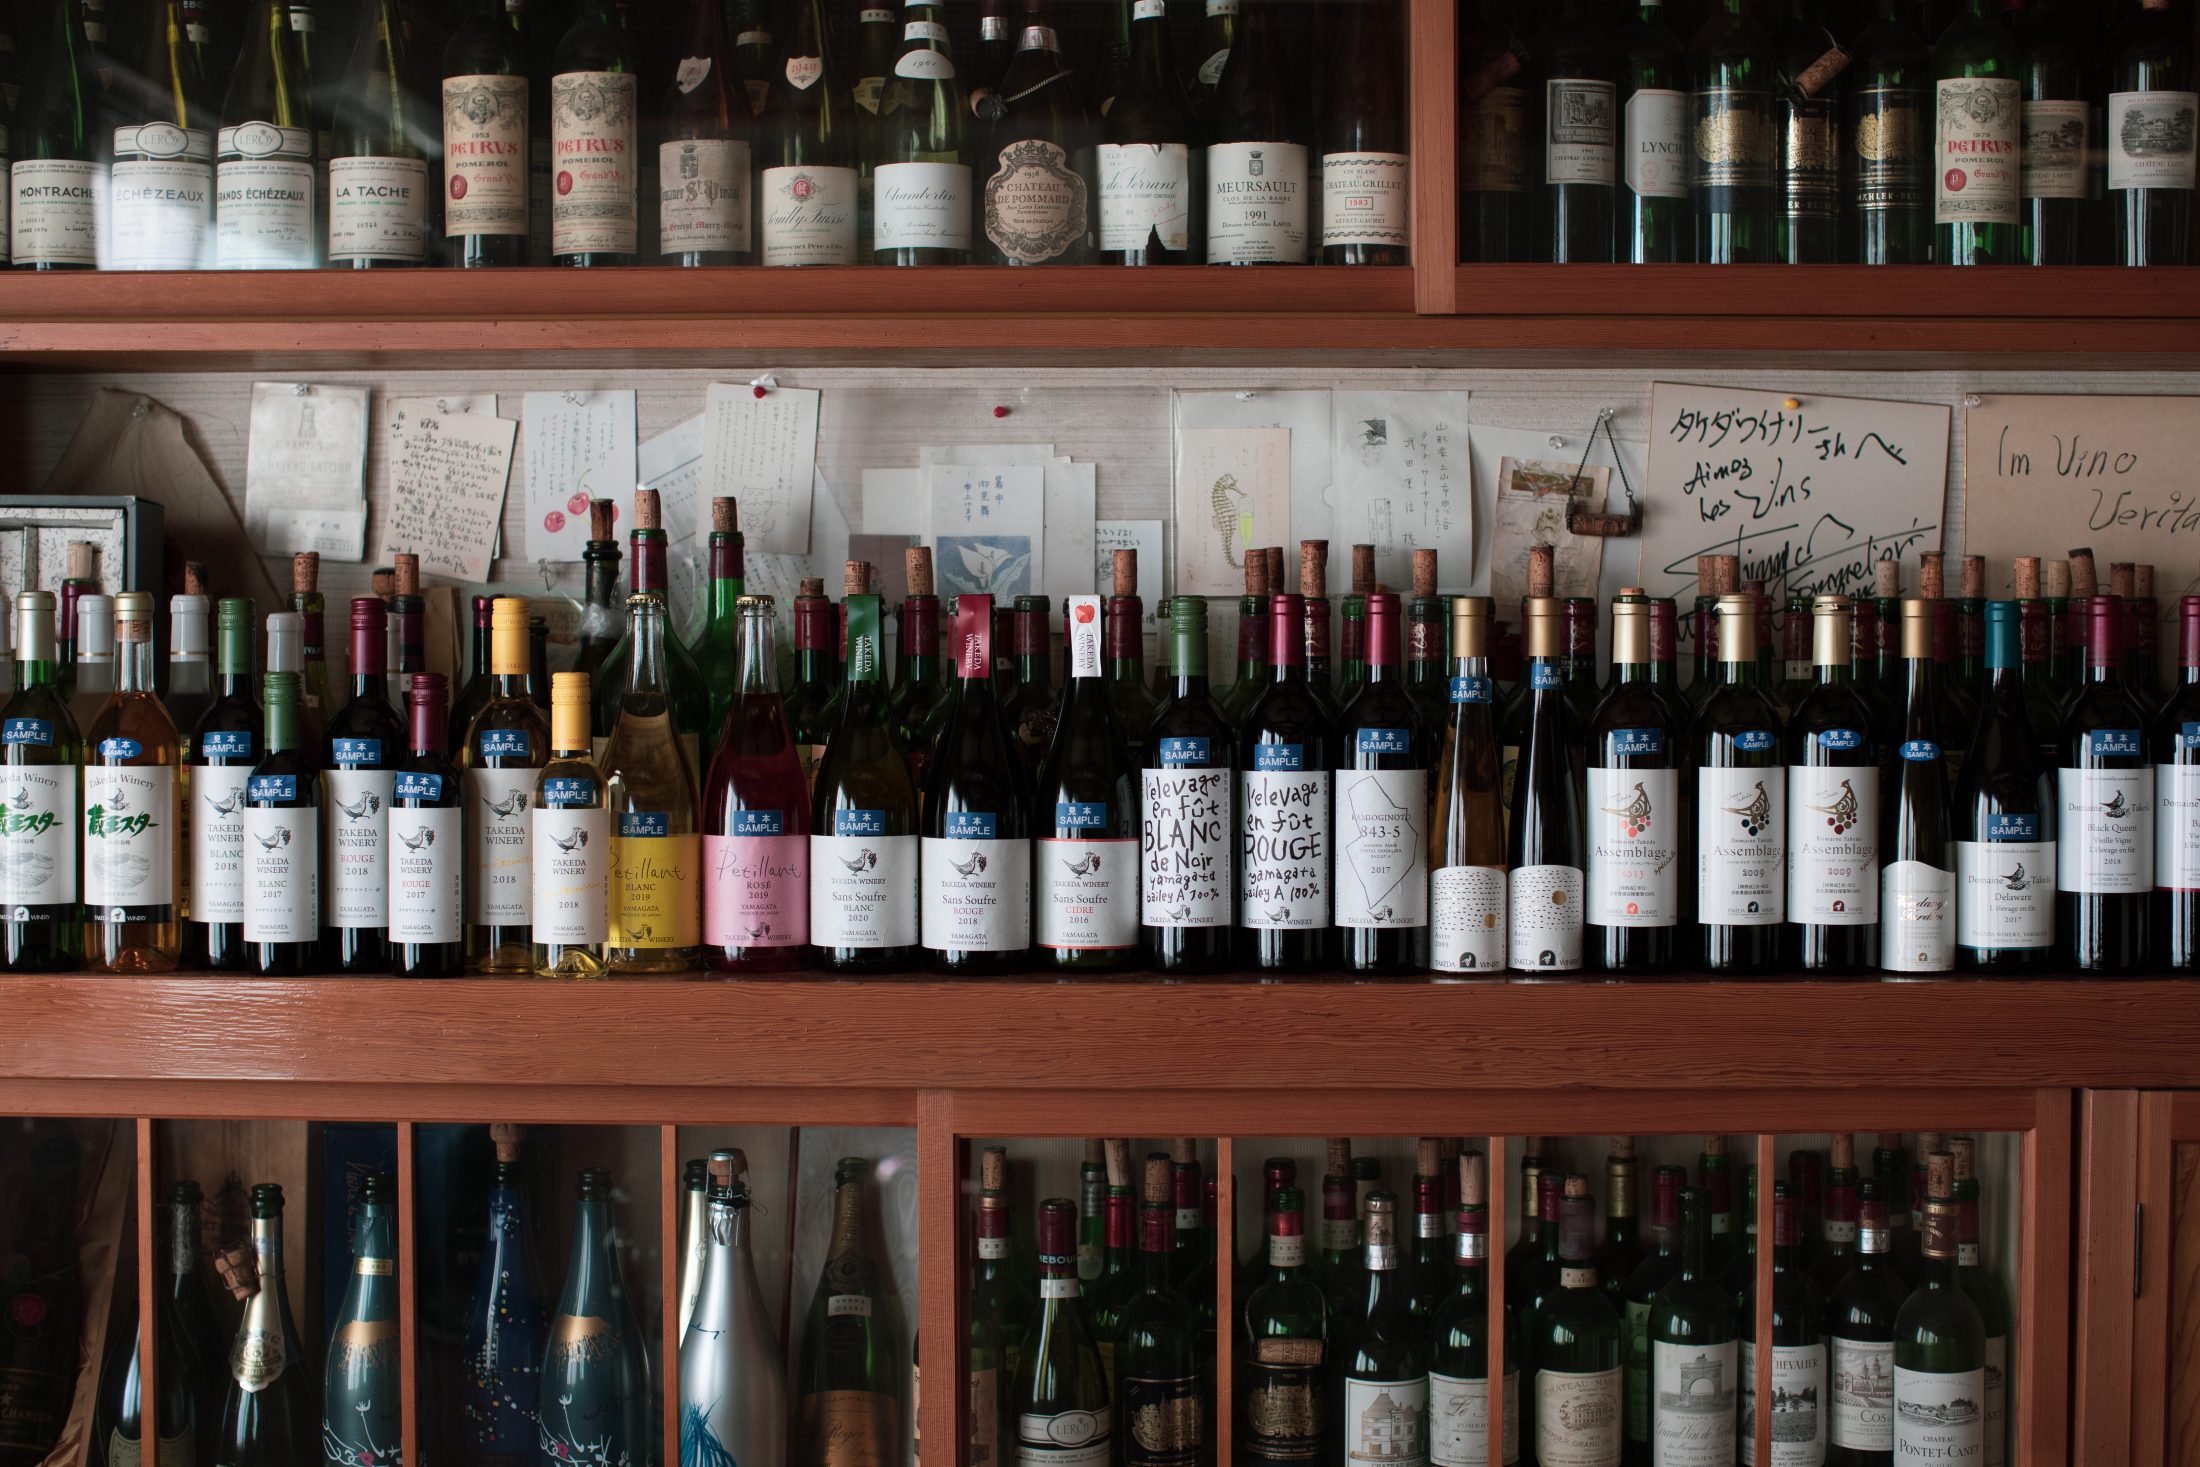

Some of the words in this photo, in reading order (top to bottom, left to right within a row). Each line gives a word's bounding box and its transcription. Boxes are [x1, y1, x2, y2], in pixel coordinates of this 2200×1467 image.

[240, 132, 276, 146] LEROY
[1642, 141, 1682, 154] LYNCH
[1024, 171, 1040, 180] 1978
[1006, 183, 1060, 192] CHATEAU
[1217, 182, 1297, 194] MEURSAULT
[116, 186, 204, 202] ÉCHÉZEAUX
[246, 187, 304, 201] ÉCHÉZEAUX
[336, 187, 350, 198] LA
[357, 186, 410, 199] TACHE
[998, 195, 1010, 204] DE
[1012, 195, 1070, 204] POMMARD
[1246, 210, 1266, 220] 1991
[2052, 434, 2138, 478] Vino
[864, 634, 872, 673] TAKEDA
[973, 632, 982, 670] TAKEDA
[1078, 632, 1086, 670] WINERY
[1086, 632, 1094, 669] TAKEDA
[16, 722, 40, 730] 見本
[6, 730, 47, 740] SAMPLE
[212, 734, 236, 743] 見本
[492, 734, 516, 743] 見本
[1371, 732, 1395, 741] 見本
[343, 742, 367, 751] 見本
[484, 743, 524, 752] SAMPLE
[1173, 741, 1196, 750] 見本
[1362, 741, 1403, 750] SAMPLE
[1616, 743, 1657, 752] SAMPLE
[1826, 739, 1855, 747] SAMPLE
[2094, 743, 2136, 752] SAMPLE
[204, 744, 245, 753] SAMPLE
[1266, 748, 1290, 756] 見本
[336, 752, 376, 761] SAMPLE
[1165, 751, 1205, 759] SAMPLE
[1258, 757, 1299, 766] SAMPLE
[259, 778, 283, 788] 見本
[405, 776, 429, 785] 見本
[398, 784, 437, 796] SAMPLE
[555, 782, 580, 790] 見本
[251, 788, 292, 797] SAMPLE
[548, 791, 588, 800] SAMPLE
[1068, 806, 1092, 814] 見本
[2068, 803, 2103, 812] Domaine
[632, 816, 655, 824] 見本
[747, 814, 770, 823] 見本
[848, 812, 872, 821] 見本
[958, 816, 982, 825] 見本
[1060, 816, 1100, 825] SAMPLE
[485, 826, 526, 835] TAKEDA
[622, 825, 664, 834] SAMPLE
[738, 823, 779, 832] SAMPLE
[840, 822, 880, 831] SAMPLE
[950, 825, 990, 835] SAMPLE
[1991, 826, 2032, 835] SAMPLE
[2088, 823, 2110, 832] Black
[2111, 823, 2137, 833] Queen
[338, 828, 378, 837] TAKEDA
[1144, 818, 1222, 852] BLANC
[1360, 825, 1400, 839] 843-5
[338, 838, 377, 847] WINERY
[485, 836, 525, 845] WINERY
[1243, 831, 1322, 870] ROUGE
[1595, 846, 1668, 859] Assemblage
[1714, 845, 1782, 857] Assemblage
[1802, 843, 1873, 856] Assemblage
[340, 854, 376, 863] ROUGE
[400, 858, 433, 866] TAKEDA
[552, 859, 586, 867] TAKEDA
[1151, 854, 1169, 872] de
[215, 862, 238, 871] 2018
[256, 866, 288, 874] WINERY
[400, 866, 432, 874] WINERY
[552, 867, 586, 875] WINERY
[1370, 866, 1391, 874] 2017
[345, 867, 368, 876] 2018
[1248, 864, 1317, 884] yamagata
[258, 880, 287, 888] BLANC
[402, 880, 430, 888] ROUGE
[492, 875, 516, 884] 2018
[1150, 871, 1216, 891] yamagata
[1968, 875, 2004, 884] Domaine
[262, 890, 282, 898] 2017
[832, 892, 853, 901] Sans
[854, 892, 887, 901] Soufre
[1994, 892, 2032, 902] Delaware
[942, 894, 963, 904] Sans
[964, 894, 997, 905] Soufre
[1054, 894, 1074, 904] Sans
[1076, 894, 1108, 904] Soufre
[559, 901, 579, 909] 2018
[844, 904, 874, 912] BLANC
[953, 907, 984, 915] ROUGE
[1066, 906, 1094, 914] CIDRE
[1069, 916, 1089, 924] 2016
[1776, 1358, 1818, 1370] HEVALIER
[1056, 1418, 1090, 1436] LEROY
[1572, 1440, 1600, 1448] GRAND
[1922, 1435, 1956, 1445] CHATEAU
[1898, 1437, 1980, 1460] PONTET-CANET
[1664, 1452, 1684, 1460] SAINT
